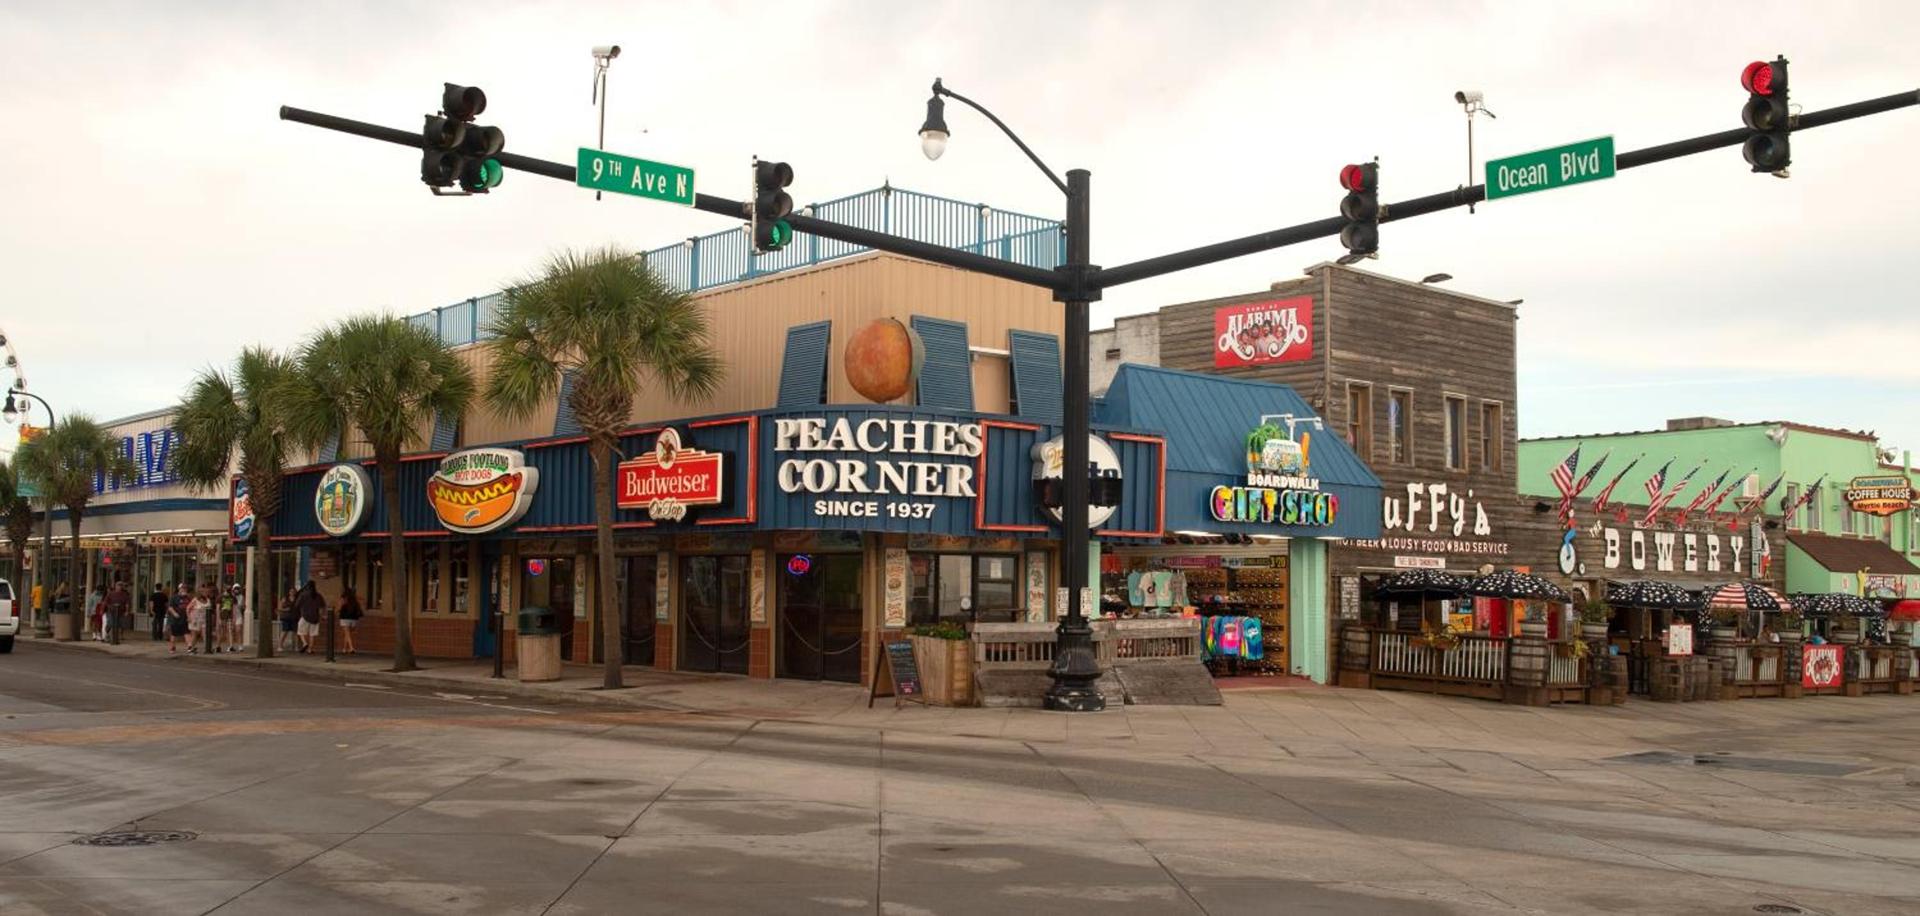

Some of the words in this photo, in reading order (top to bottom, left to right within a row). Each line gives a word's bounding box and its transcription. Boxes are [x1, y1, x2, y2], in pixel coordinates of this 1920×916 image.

[631, 164, 667, 194] Ave
[676, 172, 687, 198] N
[1498, 163, 1548, 191] Ocean
[1560, 147, 1600, 181] Blvd
[1219, 308, 1308, 361] ALABAMA
[774, 417, 983, 458] PEACHES
[455, 470, 469, 481] HOT
[471, 468, 492, 481] DOGS
[469, 453, 509, 472] FOOTLONG
[625, 467, 709, 497] Budweiser
[778, 459, 977, 498] CORNER
[1248, 472, 1320, 491] BOARDWALK
[814, 500, 879, 517] SINCE
[886, 502, 936, 519] 1937
[1210, 485, 1278, 523] GIFT
[1280, 489, 1340, 526] SHOP
[1847, 489, 1880, 501] COFFEE
[1881, 488, 1911, 500] HOUSE
[150, 536, 193, 544] BOWLING
[1388, 538, 1419, 550] LOUSY
[1421, 540, 1446, 552] FOOD
[1453, 541, 1471, 553] BAD
[1472, 542, 1508, 554] SERVICE
[1604, 527, 1743, 572] BOWERY
